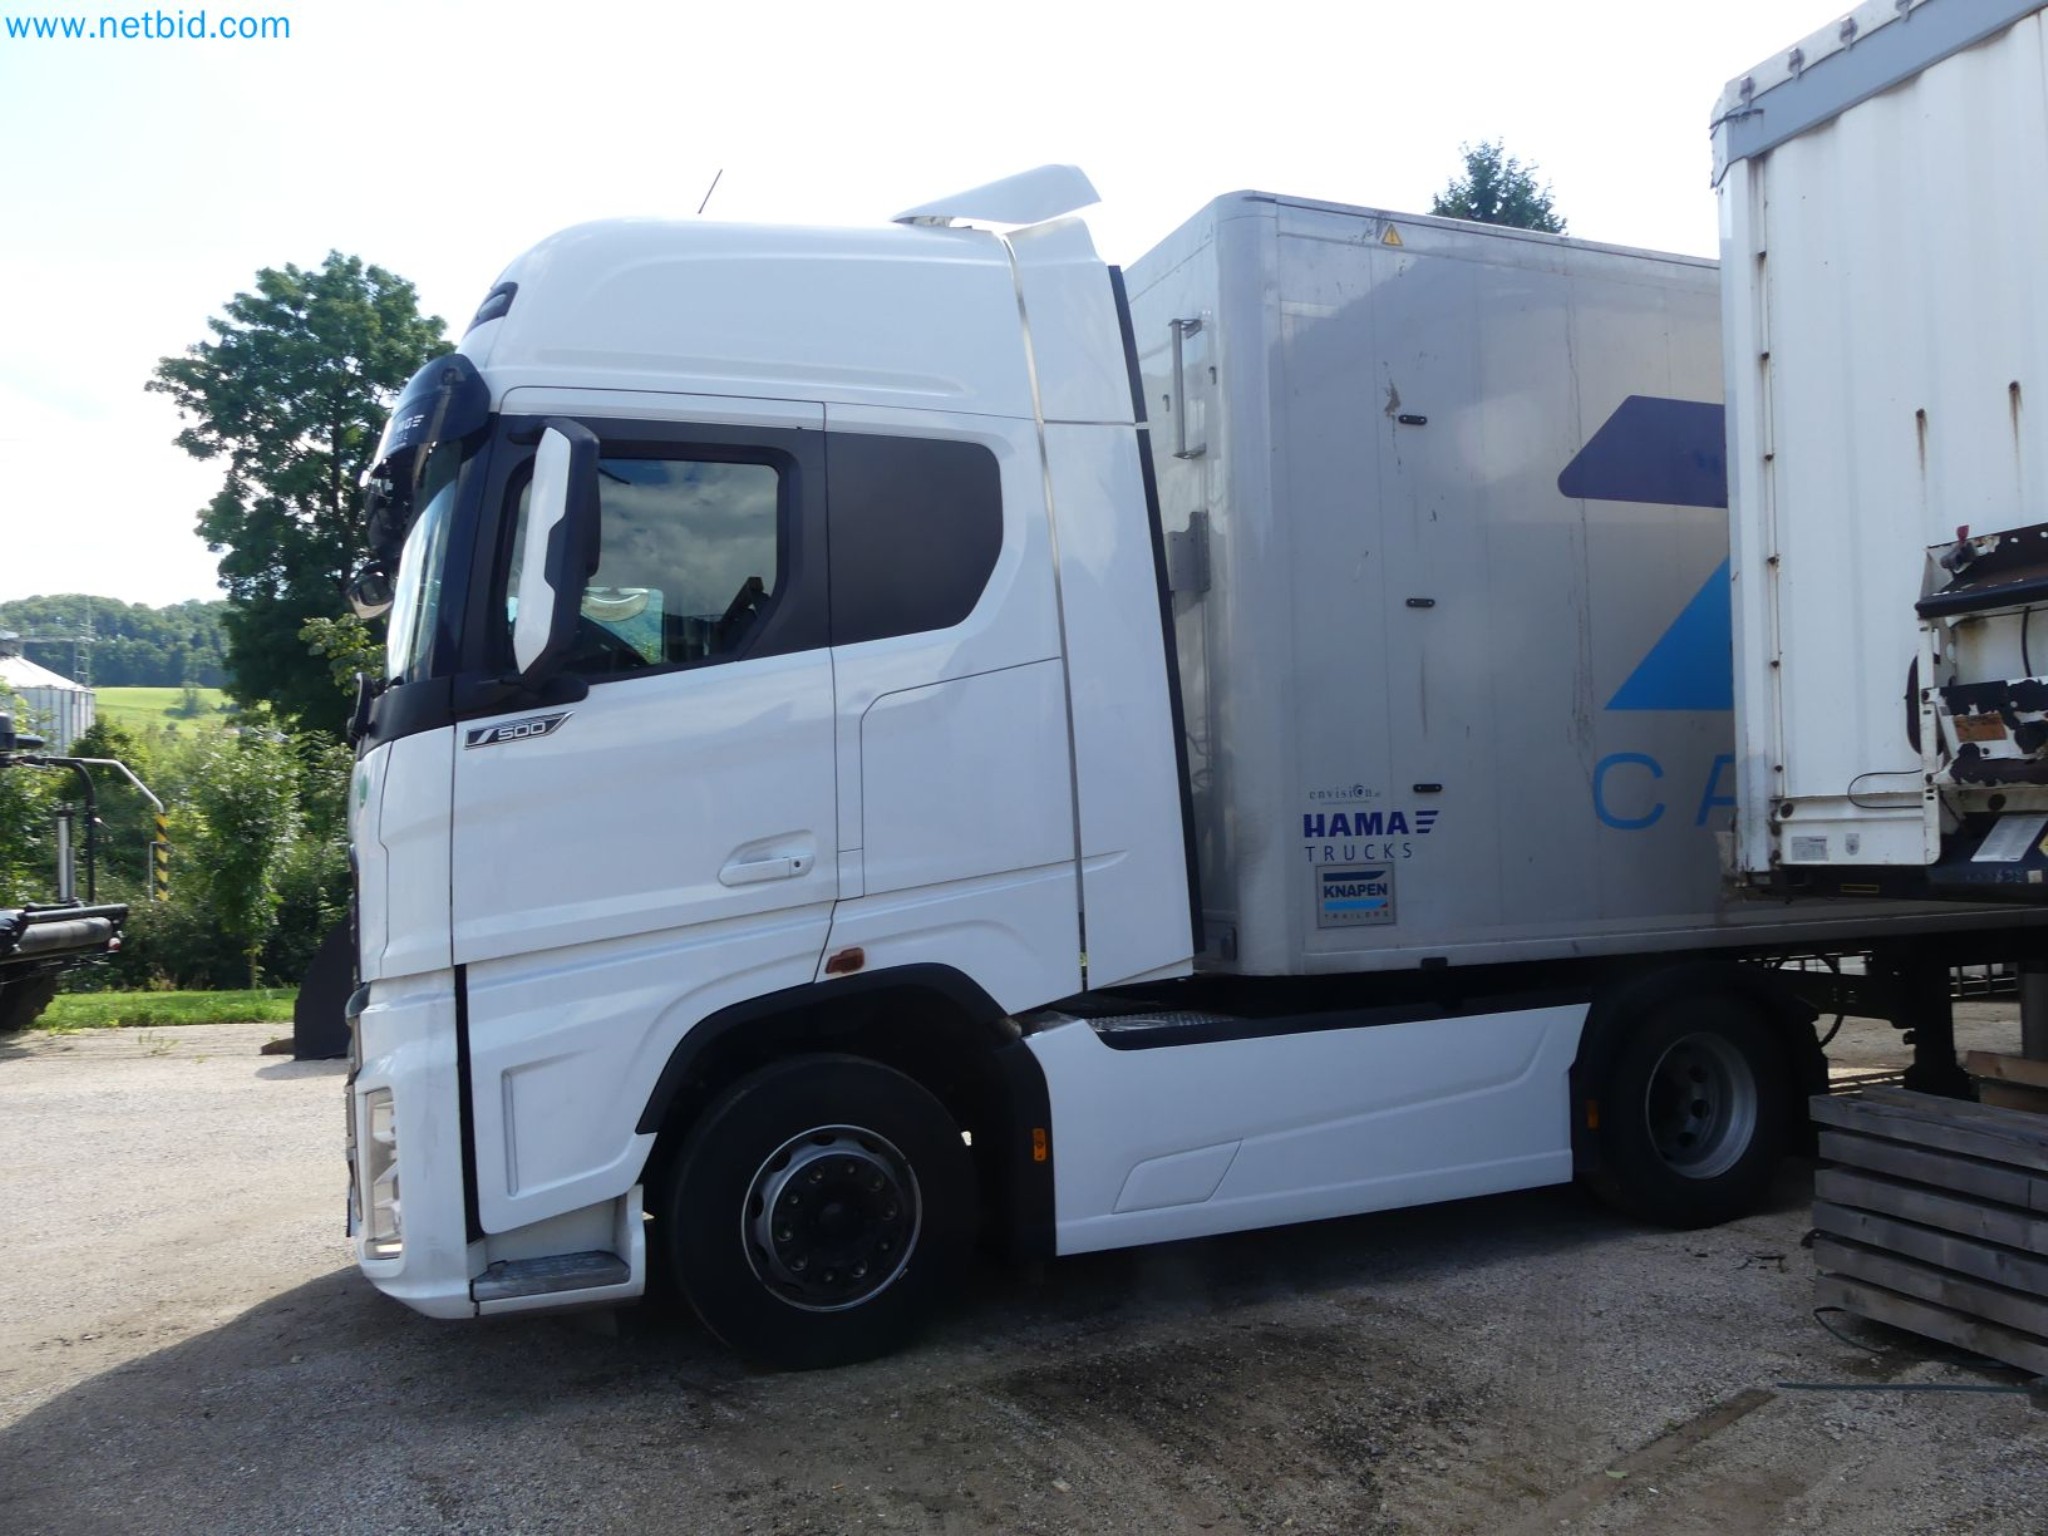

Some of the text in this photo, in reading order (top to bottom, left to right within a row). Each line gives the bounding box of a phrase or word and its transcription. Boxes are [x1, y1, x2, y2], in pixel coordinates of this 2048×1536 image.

[498, 722, 546, 741] 500
[1303, 811, 1410, 838] HAMA
[1305, 842, 1412, 862] TRUCKS
[1323, 883, 1388, 898] KNAPEN
